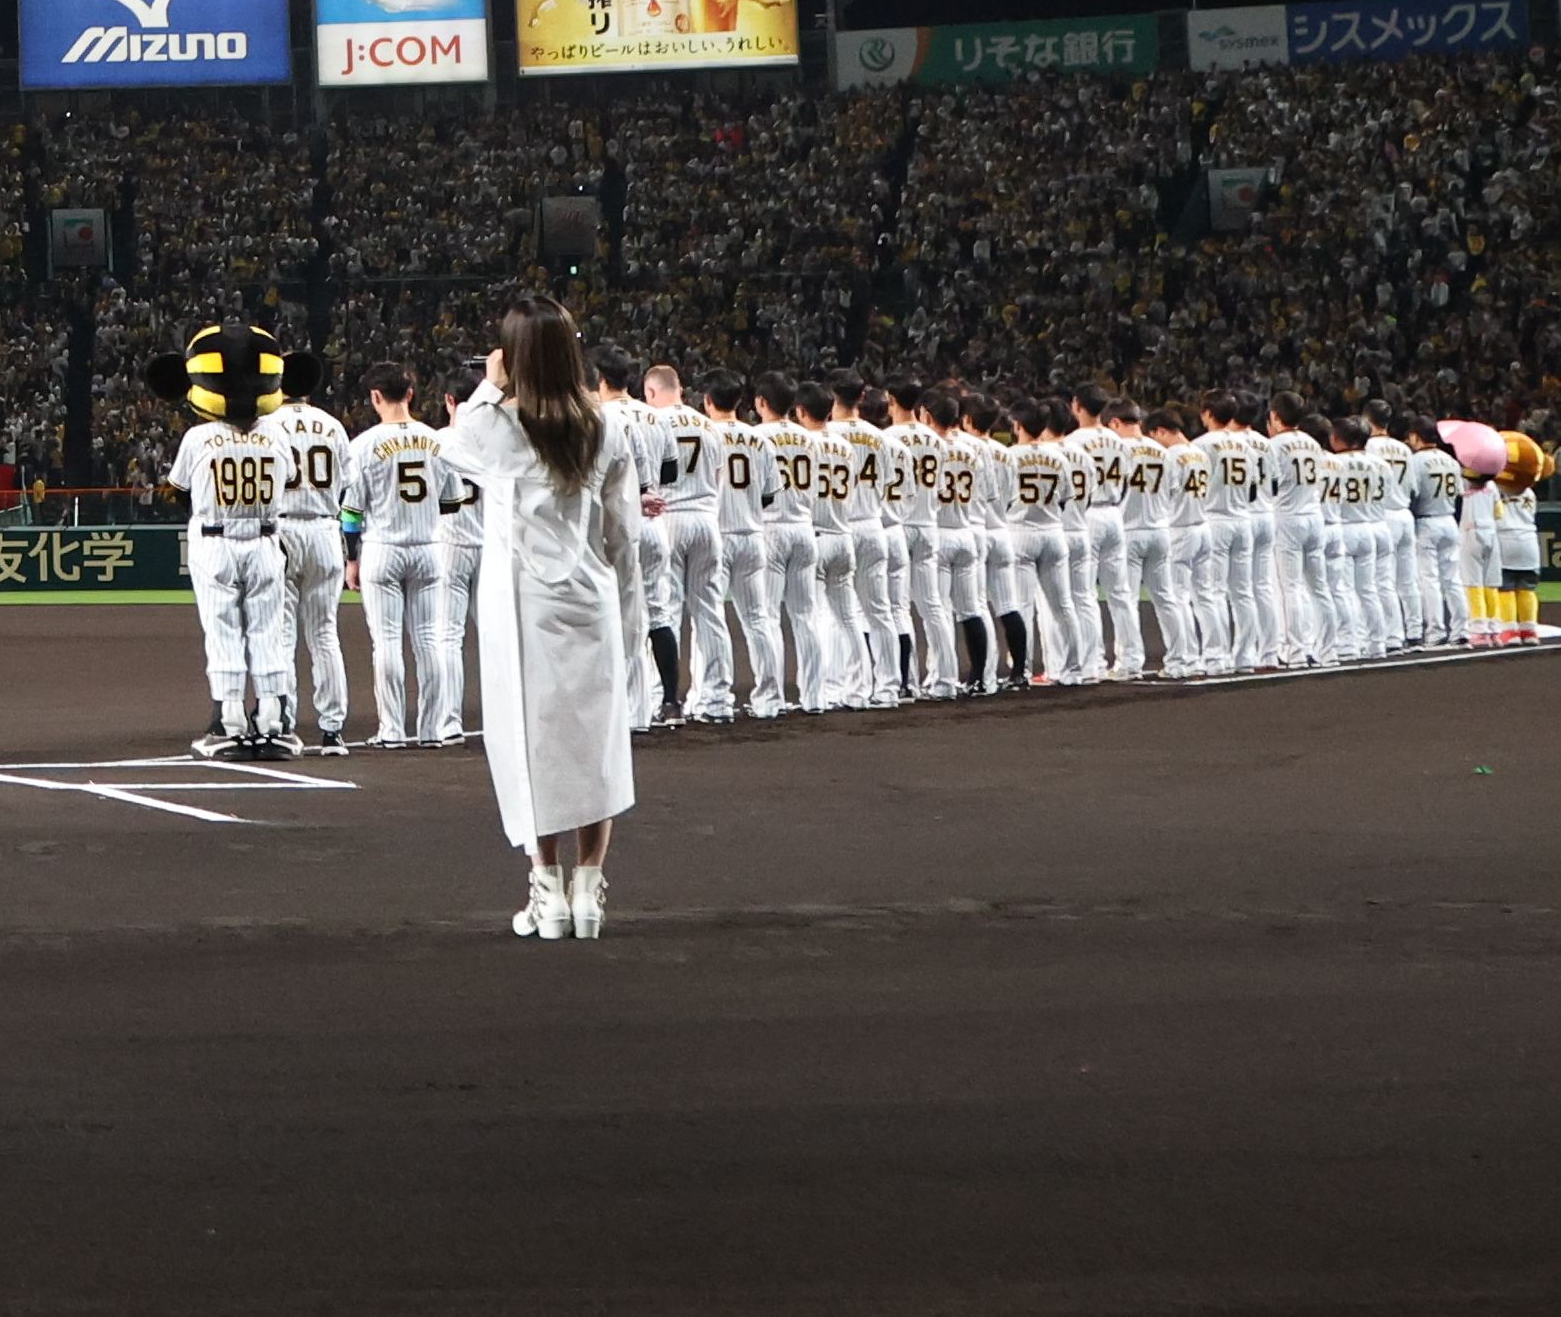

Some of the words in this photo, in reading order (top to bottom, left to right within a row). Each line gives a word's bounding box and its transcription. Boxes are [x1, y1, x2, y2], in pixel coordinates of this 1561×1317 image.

[1293, 0, 1518, 55] シスメックス
[341, 35, 462, 76] J:COM
[531, 35, 790, 61] やっぱりビールはおいしい、うれしい。
[954, 29, 1138, 72] りそな銀行
[205, 432, 274, 448] TO-LUCKY
[372, 434, 441, 460] CHIKAMOTO
[676, 436, 700, 473] 7
[901, 435, 941, 452] BATA
[210, 455, 276, 507] 1985
[397, 461, 427, 503] 5
[728, 453, 751, 490] 0
[1130, 463, 1164, 494] 47
[1221, 457, 1247, 485] 15
[1292, 457, 1317, 485] 13
[1430, 473, 1456, 498] 78
[1019, 473, 1059, 504] 57
